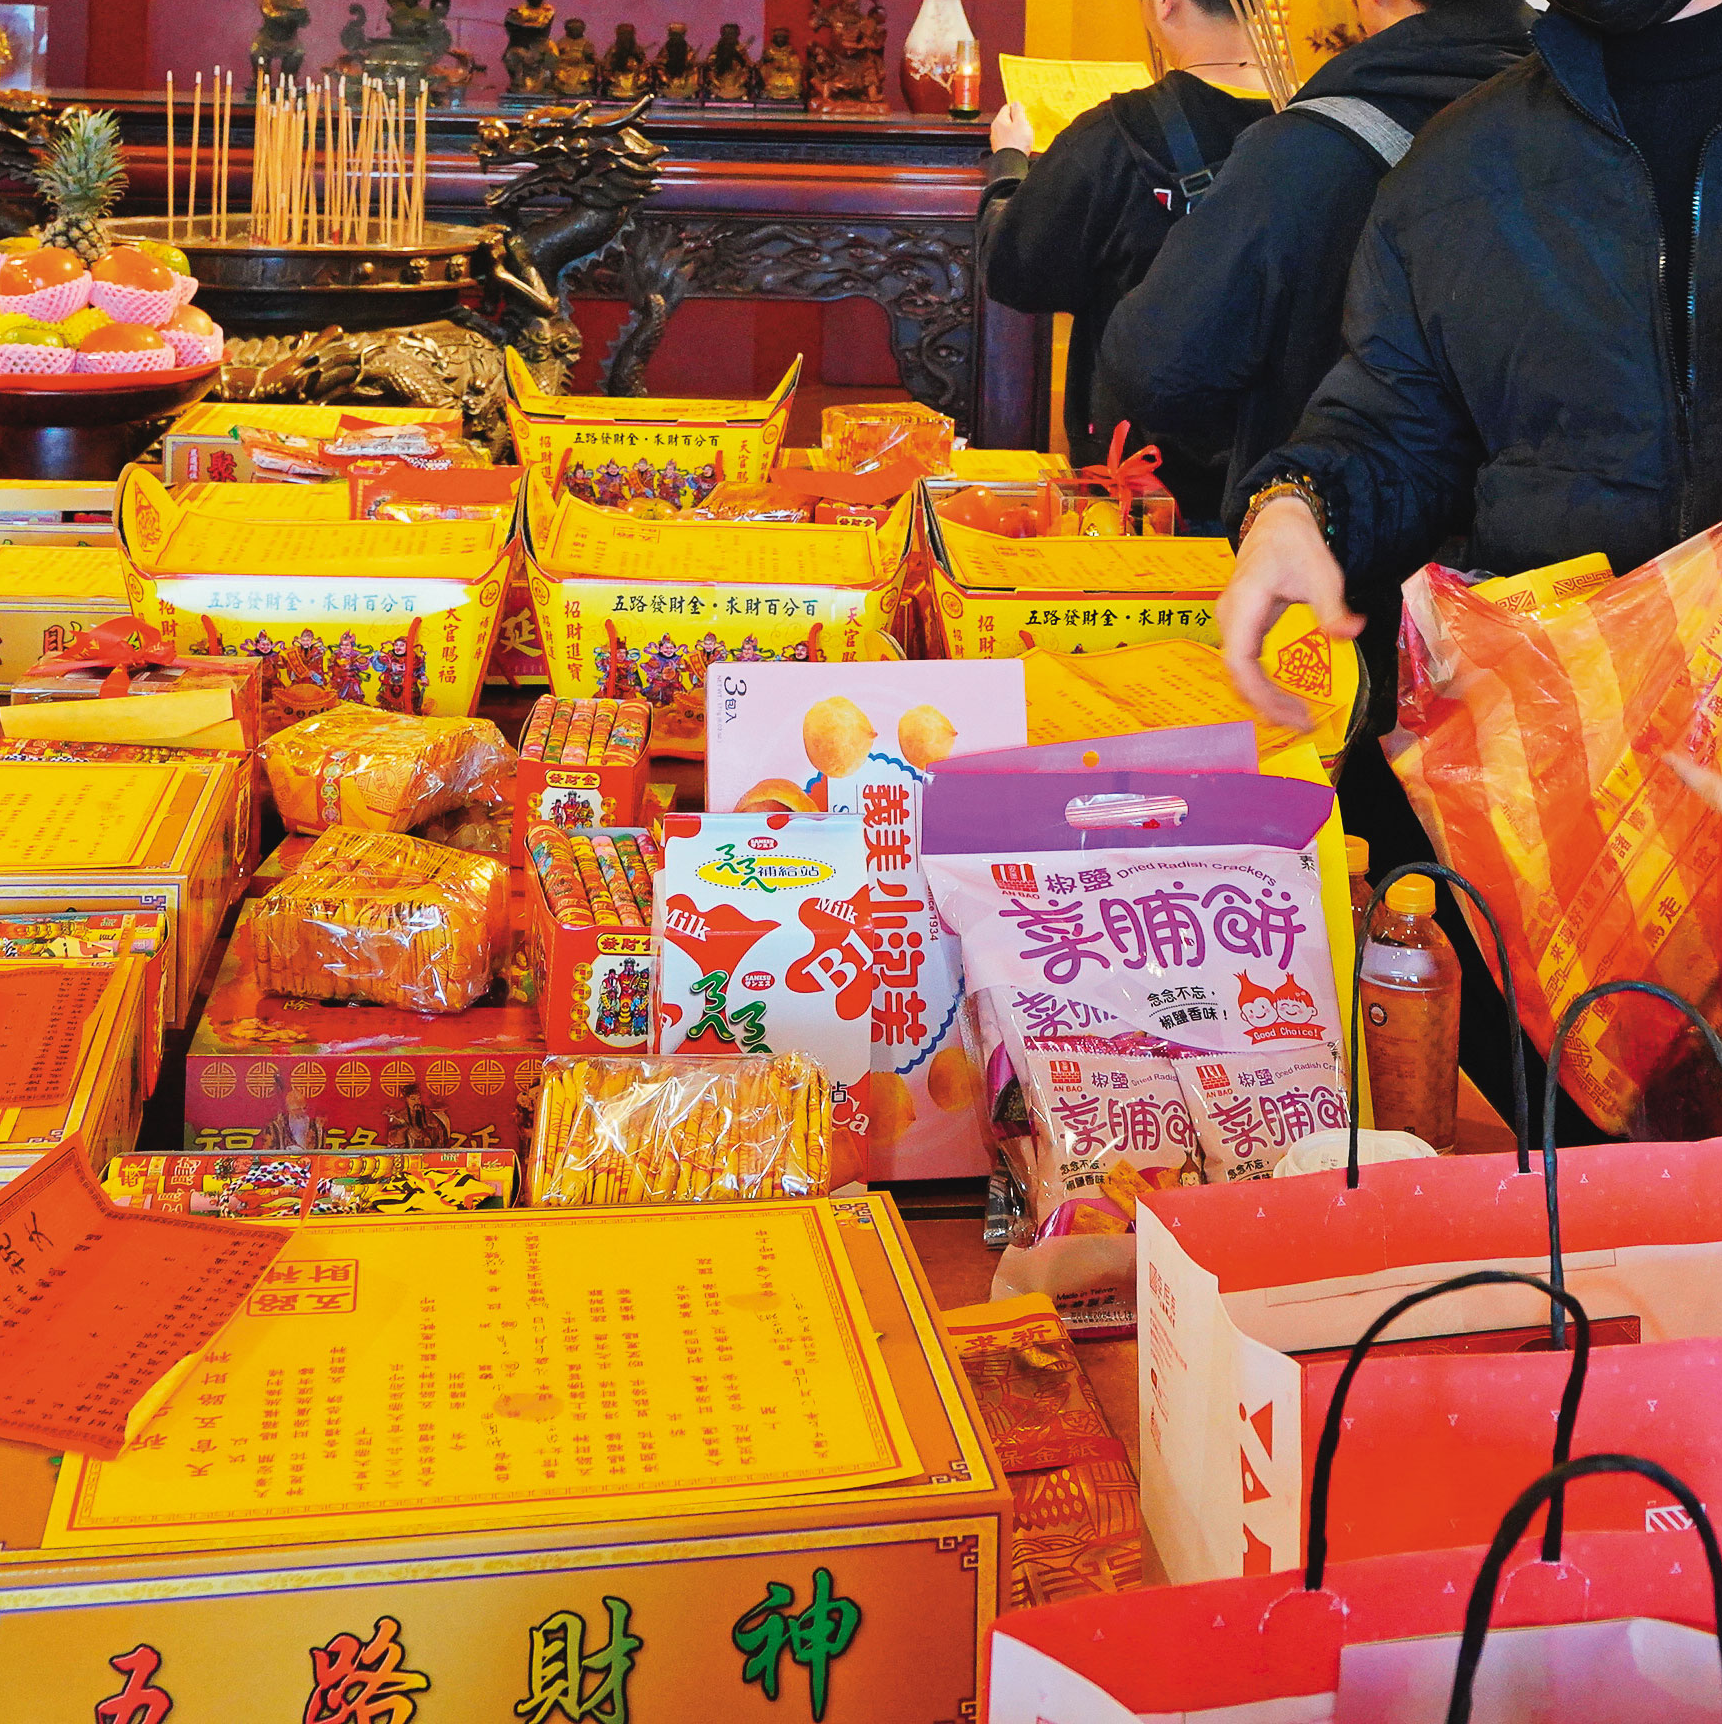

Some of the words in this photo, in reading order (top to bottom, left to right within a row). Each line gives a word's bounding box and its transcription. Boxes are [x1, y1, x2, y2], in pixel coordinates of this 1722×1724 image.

[564, 600, 584, 682] 招財進寶
[757, 865, 820, 878] 補給站
[1045, 867, 1115, 895] 椒鹽
[1117, 862, 1155, 880] Dried
[1157, 860, 1208, 870] Radish
[1211, 862, 1277, 887] Crackers
[1001, 889, 1017, 897] AN
[1018, 890, 1040, 899] BAO
[664, 903, 712, 942] Milk
[814, 896, 860, 925] Milk
[929, 916, 940, 943] 1934
[999, 881, 1306, 984] 菜脯餅
[1253, 1029, 1276, 1041] Good
[1279, 1028, 1321, 1039] Choice!
[1238, 1069, 1275, 1088] 椒鹽
[1295, 1061, 1322, 1073] Radish
[1053, 1085, 1064, 1093] AN
[1091, 1072, 1129, 1089] 椒鹽
[244, 1289, 352, 1314] 五路
